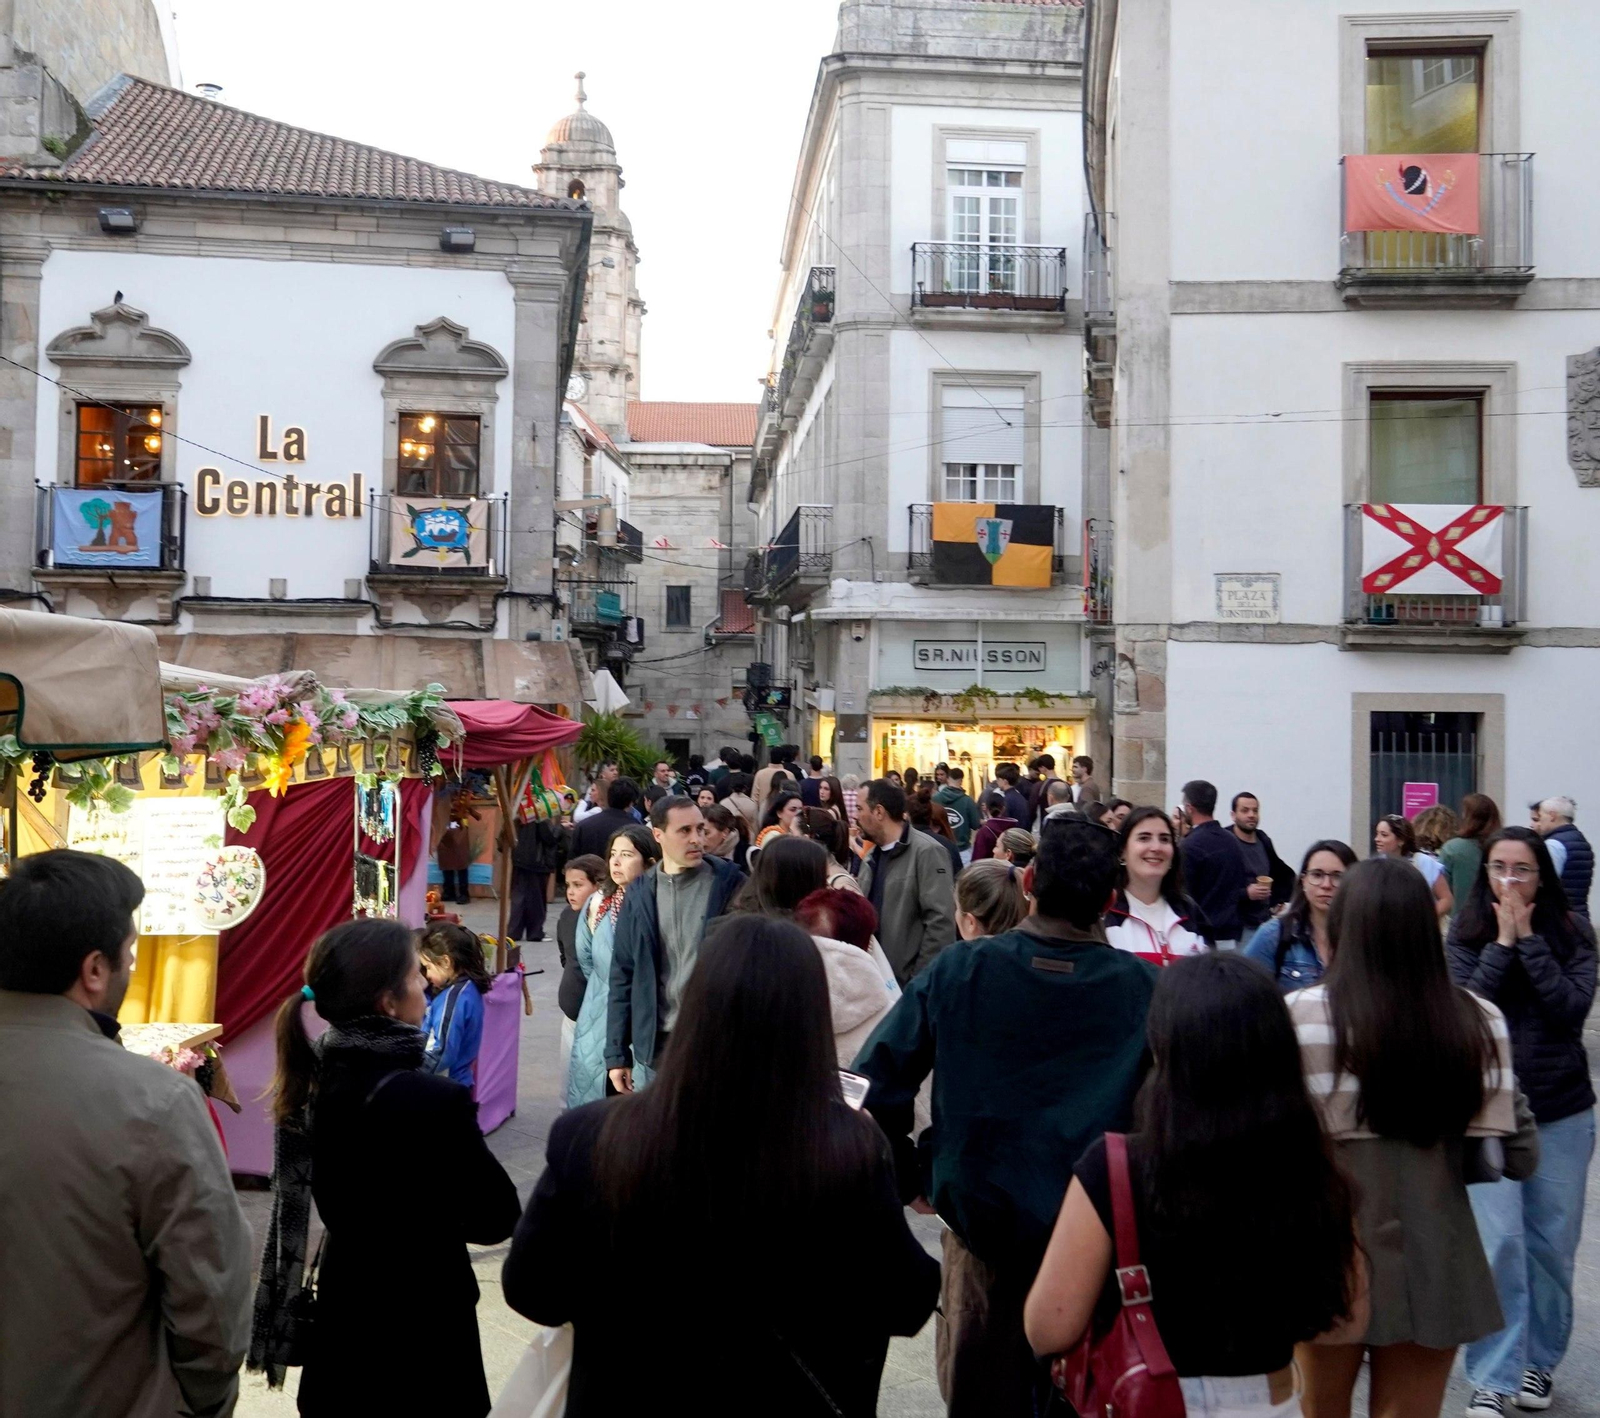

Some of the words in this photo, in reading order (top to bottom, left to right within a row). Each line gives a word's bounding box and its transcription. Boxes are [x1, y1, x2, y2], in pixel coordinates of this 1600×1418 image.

[259, 415, 306, 461] La
[197, 468, 362, 517] Central
[1227, 590, 1266, 601] PLAZA
